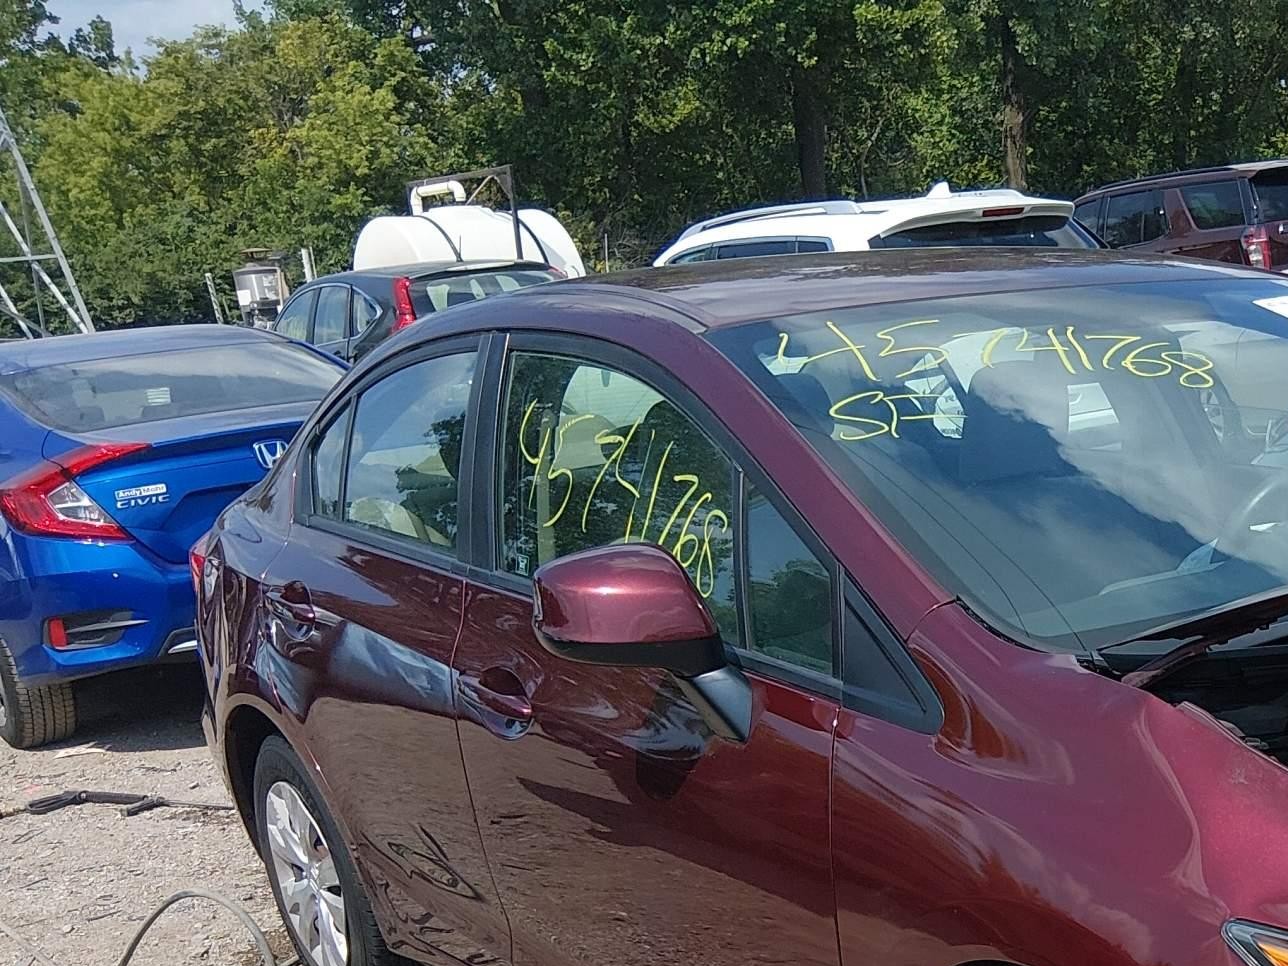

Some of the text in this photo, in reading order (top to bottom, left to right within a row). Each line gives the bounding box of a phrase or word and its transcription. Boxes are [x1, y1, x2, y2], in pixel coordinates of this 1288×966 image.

[777, 318, 1215, 389] 45741768
[116, 493, 171, 510] CIVIC
[117, 488, 142, 499] Andy
